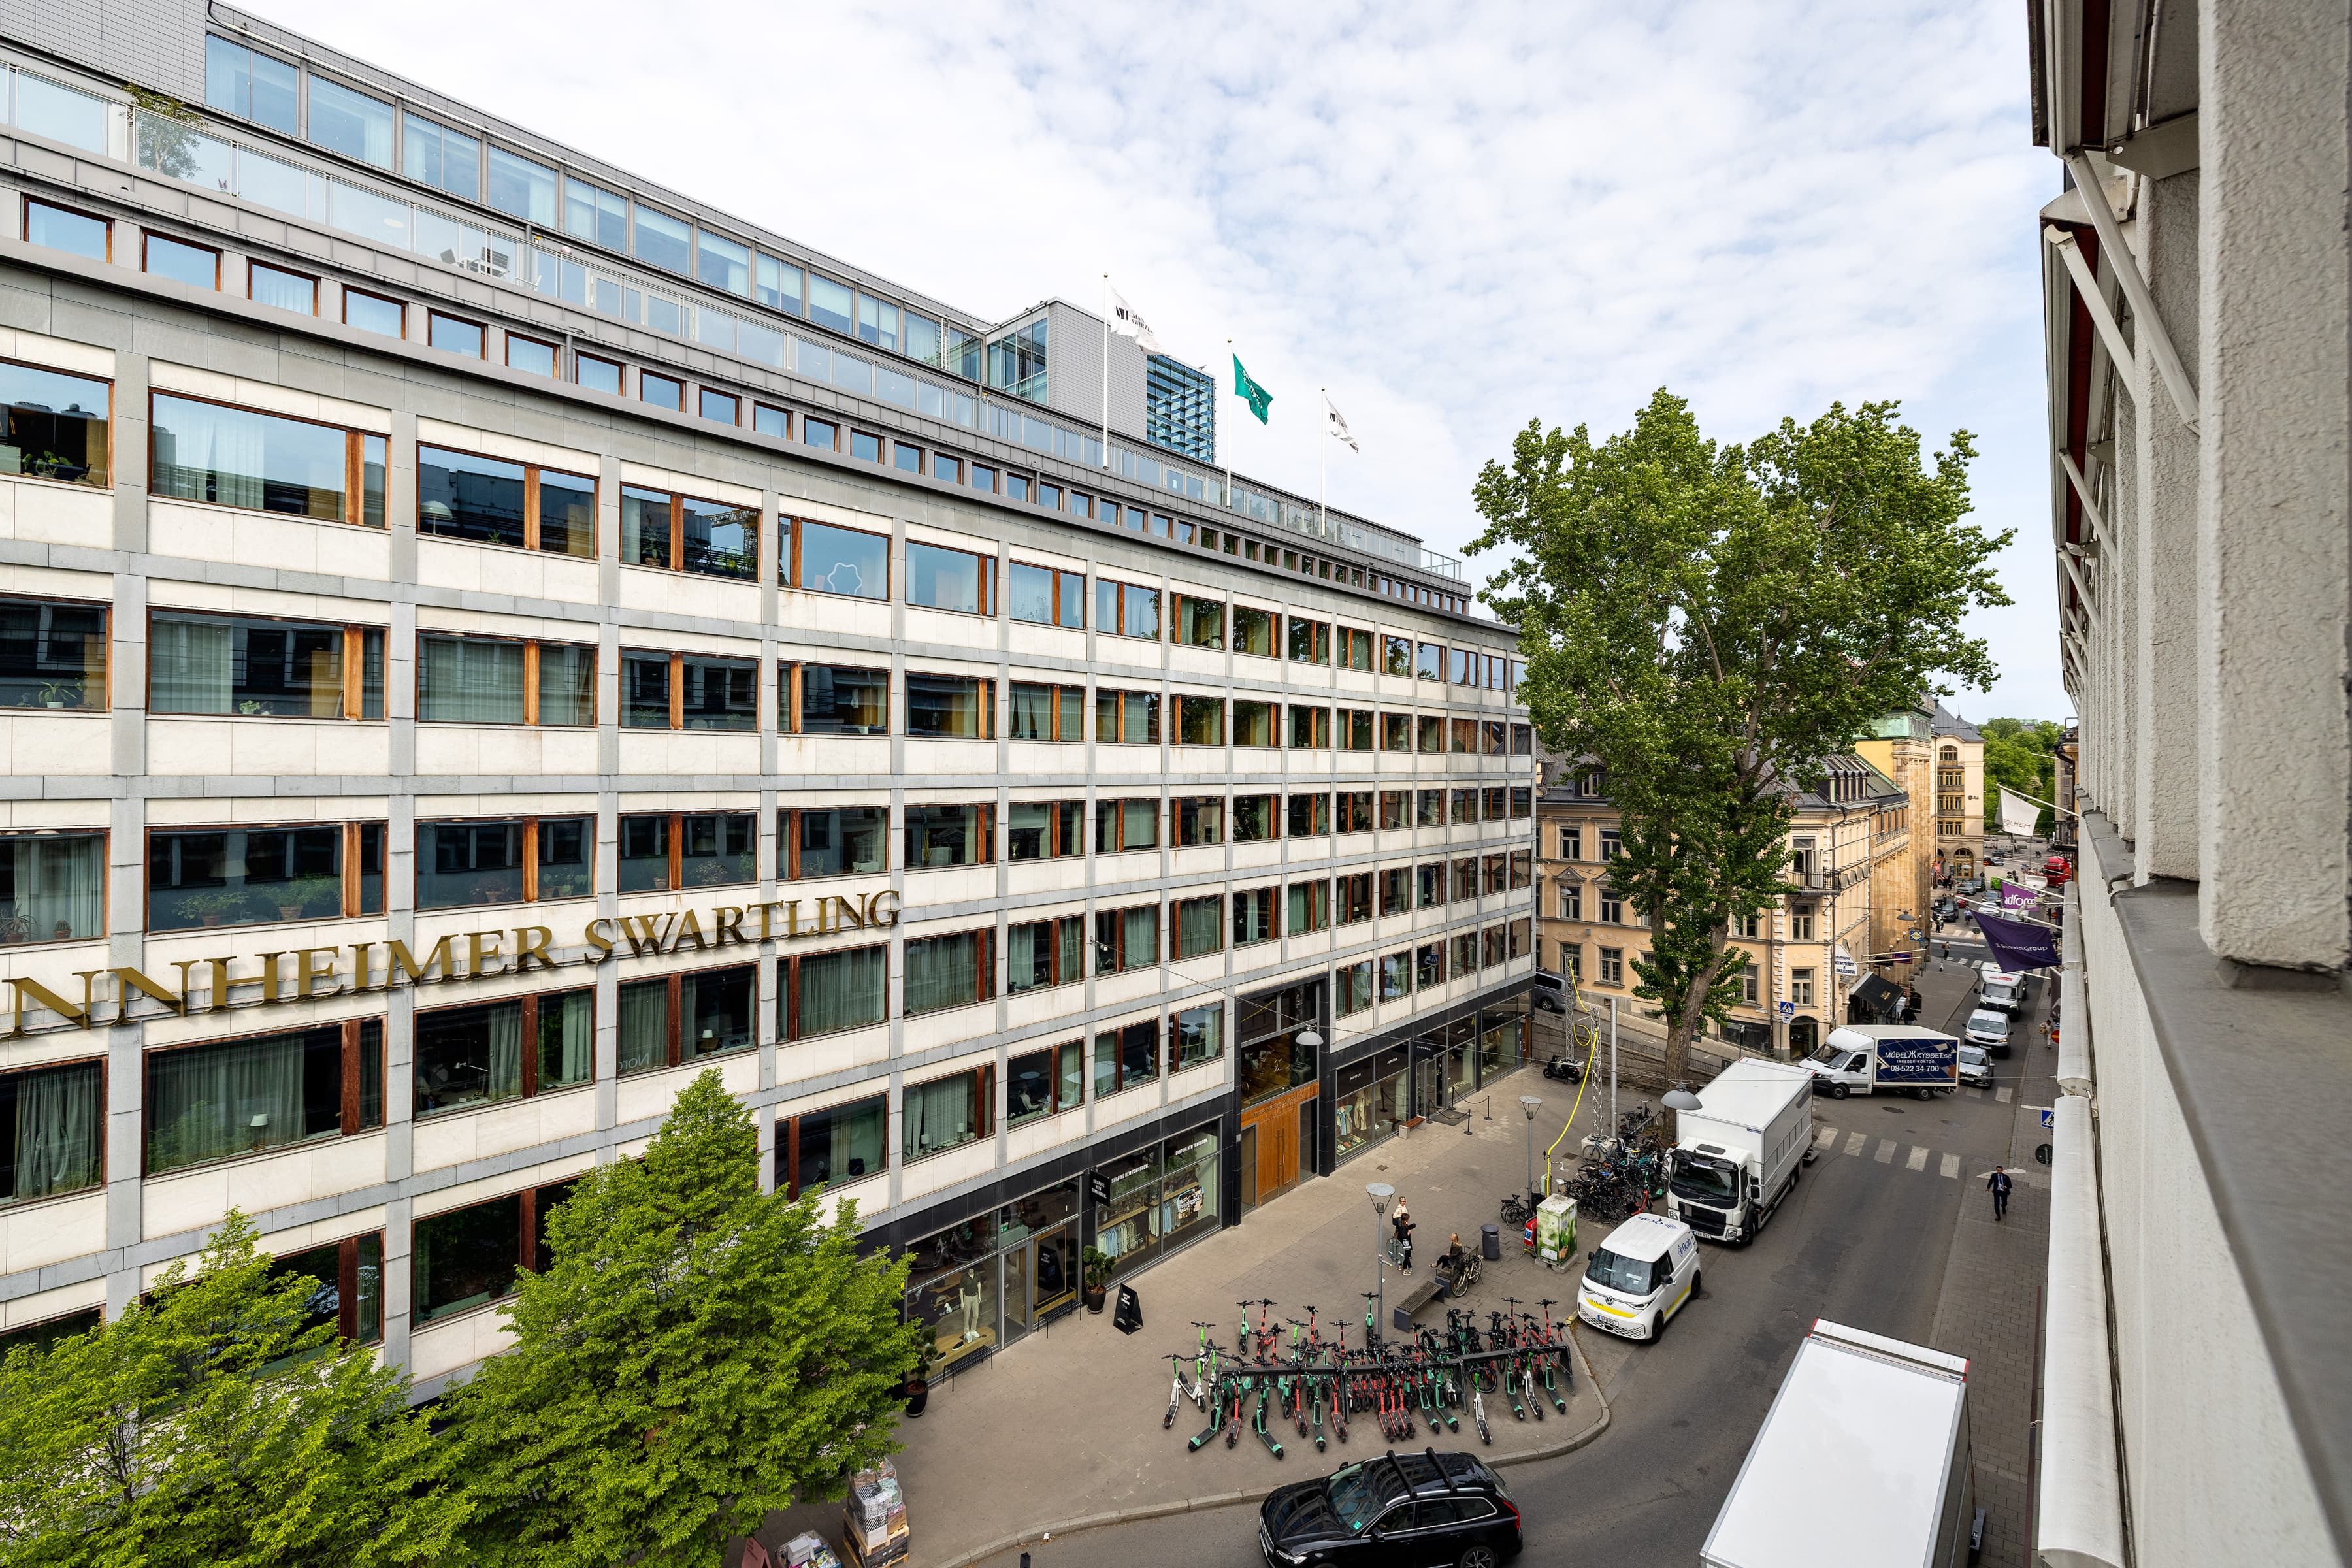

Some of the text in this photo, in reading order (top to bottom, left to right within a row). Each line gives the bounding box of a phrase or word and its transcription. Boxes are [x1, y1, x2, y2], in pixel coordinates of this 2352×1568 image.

[583, 890, 900, 965] SWARTLING
[1111, 1171, 1125, 1184] SHAPING
[1638, 1217, 1663, 1226] Ocab
[1682, 1238, 1691, 1252] Ocab
